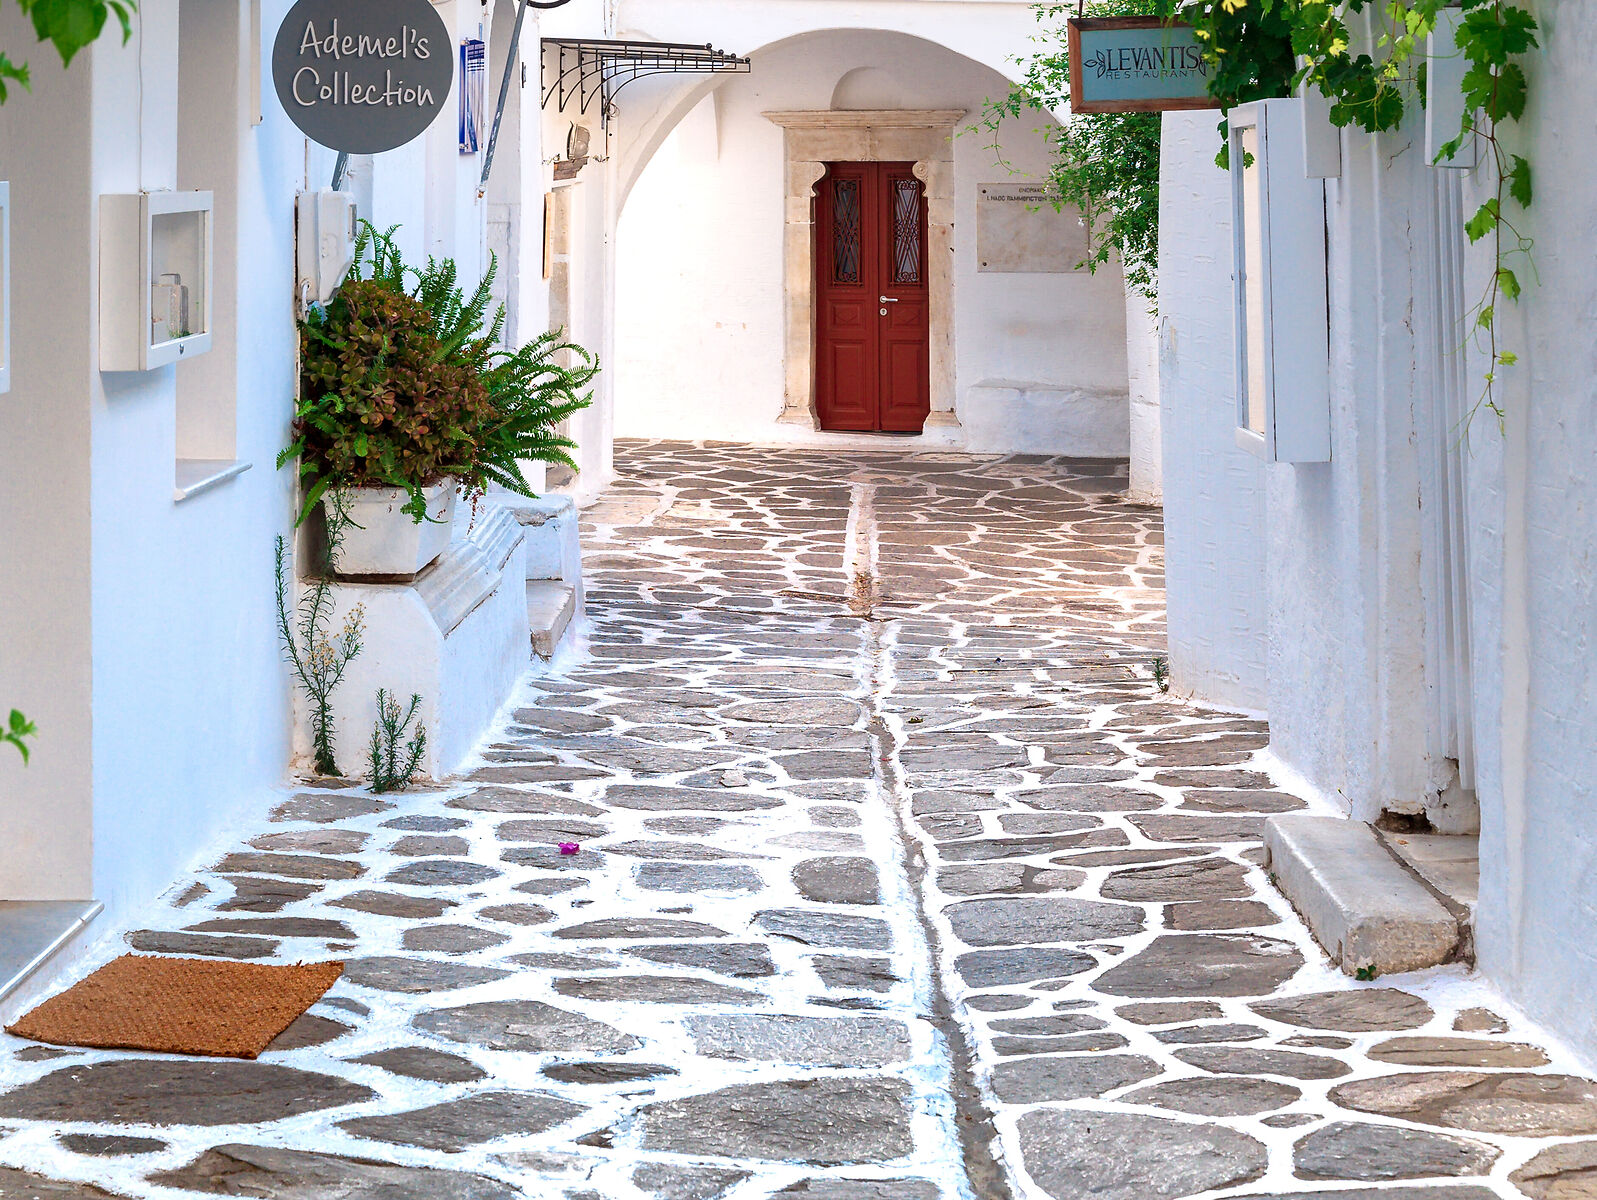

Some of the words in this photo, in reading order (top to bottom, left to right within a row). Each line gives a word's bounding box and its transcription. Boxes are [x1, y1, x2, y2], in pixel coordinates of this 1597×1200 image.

[299, 18, 431, 60] Ademel's
[1106, 45, 1199, 71] LEVANTIS
[292, 66, 435, 106] Collection
[1105, 70, 1196, 80] RESTAURANT
